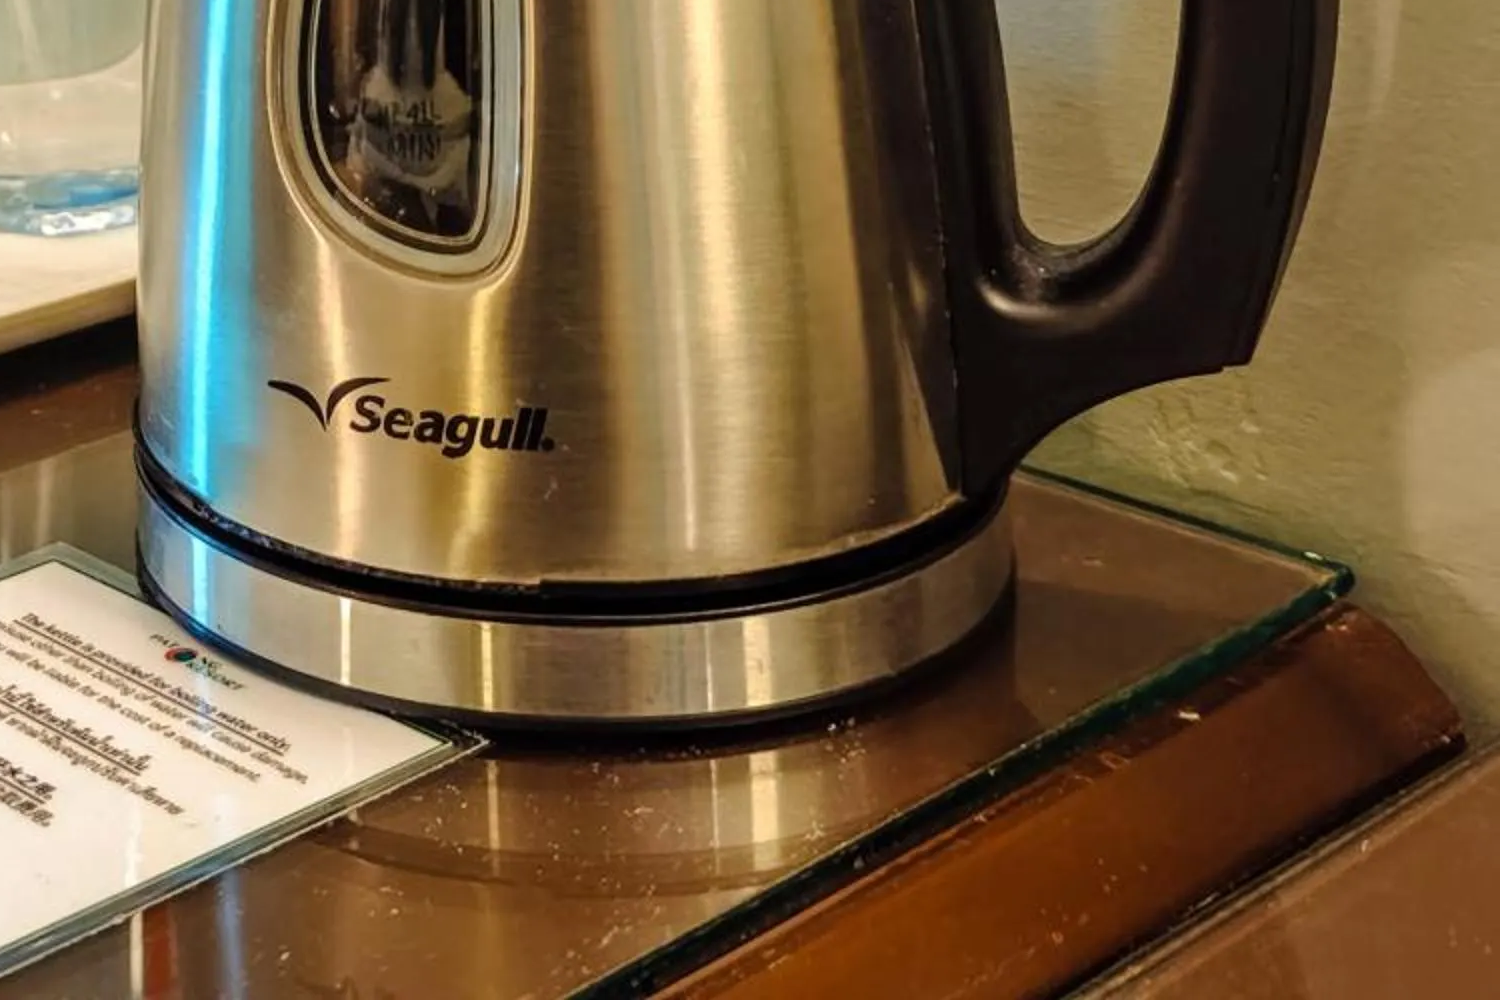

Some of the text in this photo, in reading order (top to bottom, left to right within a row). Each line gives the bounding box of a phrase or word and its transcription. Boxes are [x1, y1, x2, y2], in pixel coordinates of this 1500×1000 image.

[5, 649, 32, 663] will
[26, 659, 46, 671] be
[42, 667, 81, 689] liable
[76, 684, 100, 697] for
[96, 696, 123, 710] the
[119, 707, 151, 725] cost
[147, 722, 171, 732] of
[22, 613, 47, 626] The
[44, 624, 83, 646] kettle
[78, 644, 96, 653] is
[95, 649, 155, 679] provided
[147, 676, 173, 690] for
[170, 685, 218, 714] boiling
[216, 711, 259, 732] water
[31, 640, 66, 658] other
[62, 655, 95, 674] than
[90, 669, 137, 697] boiling
[150, 699, 189, 721] water
[211, 730, 252, 753] cause
